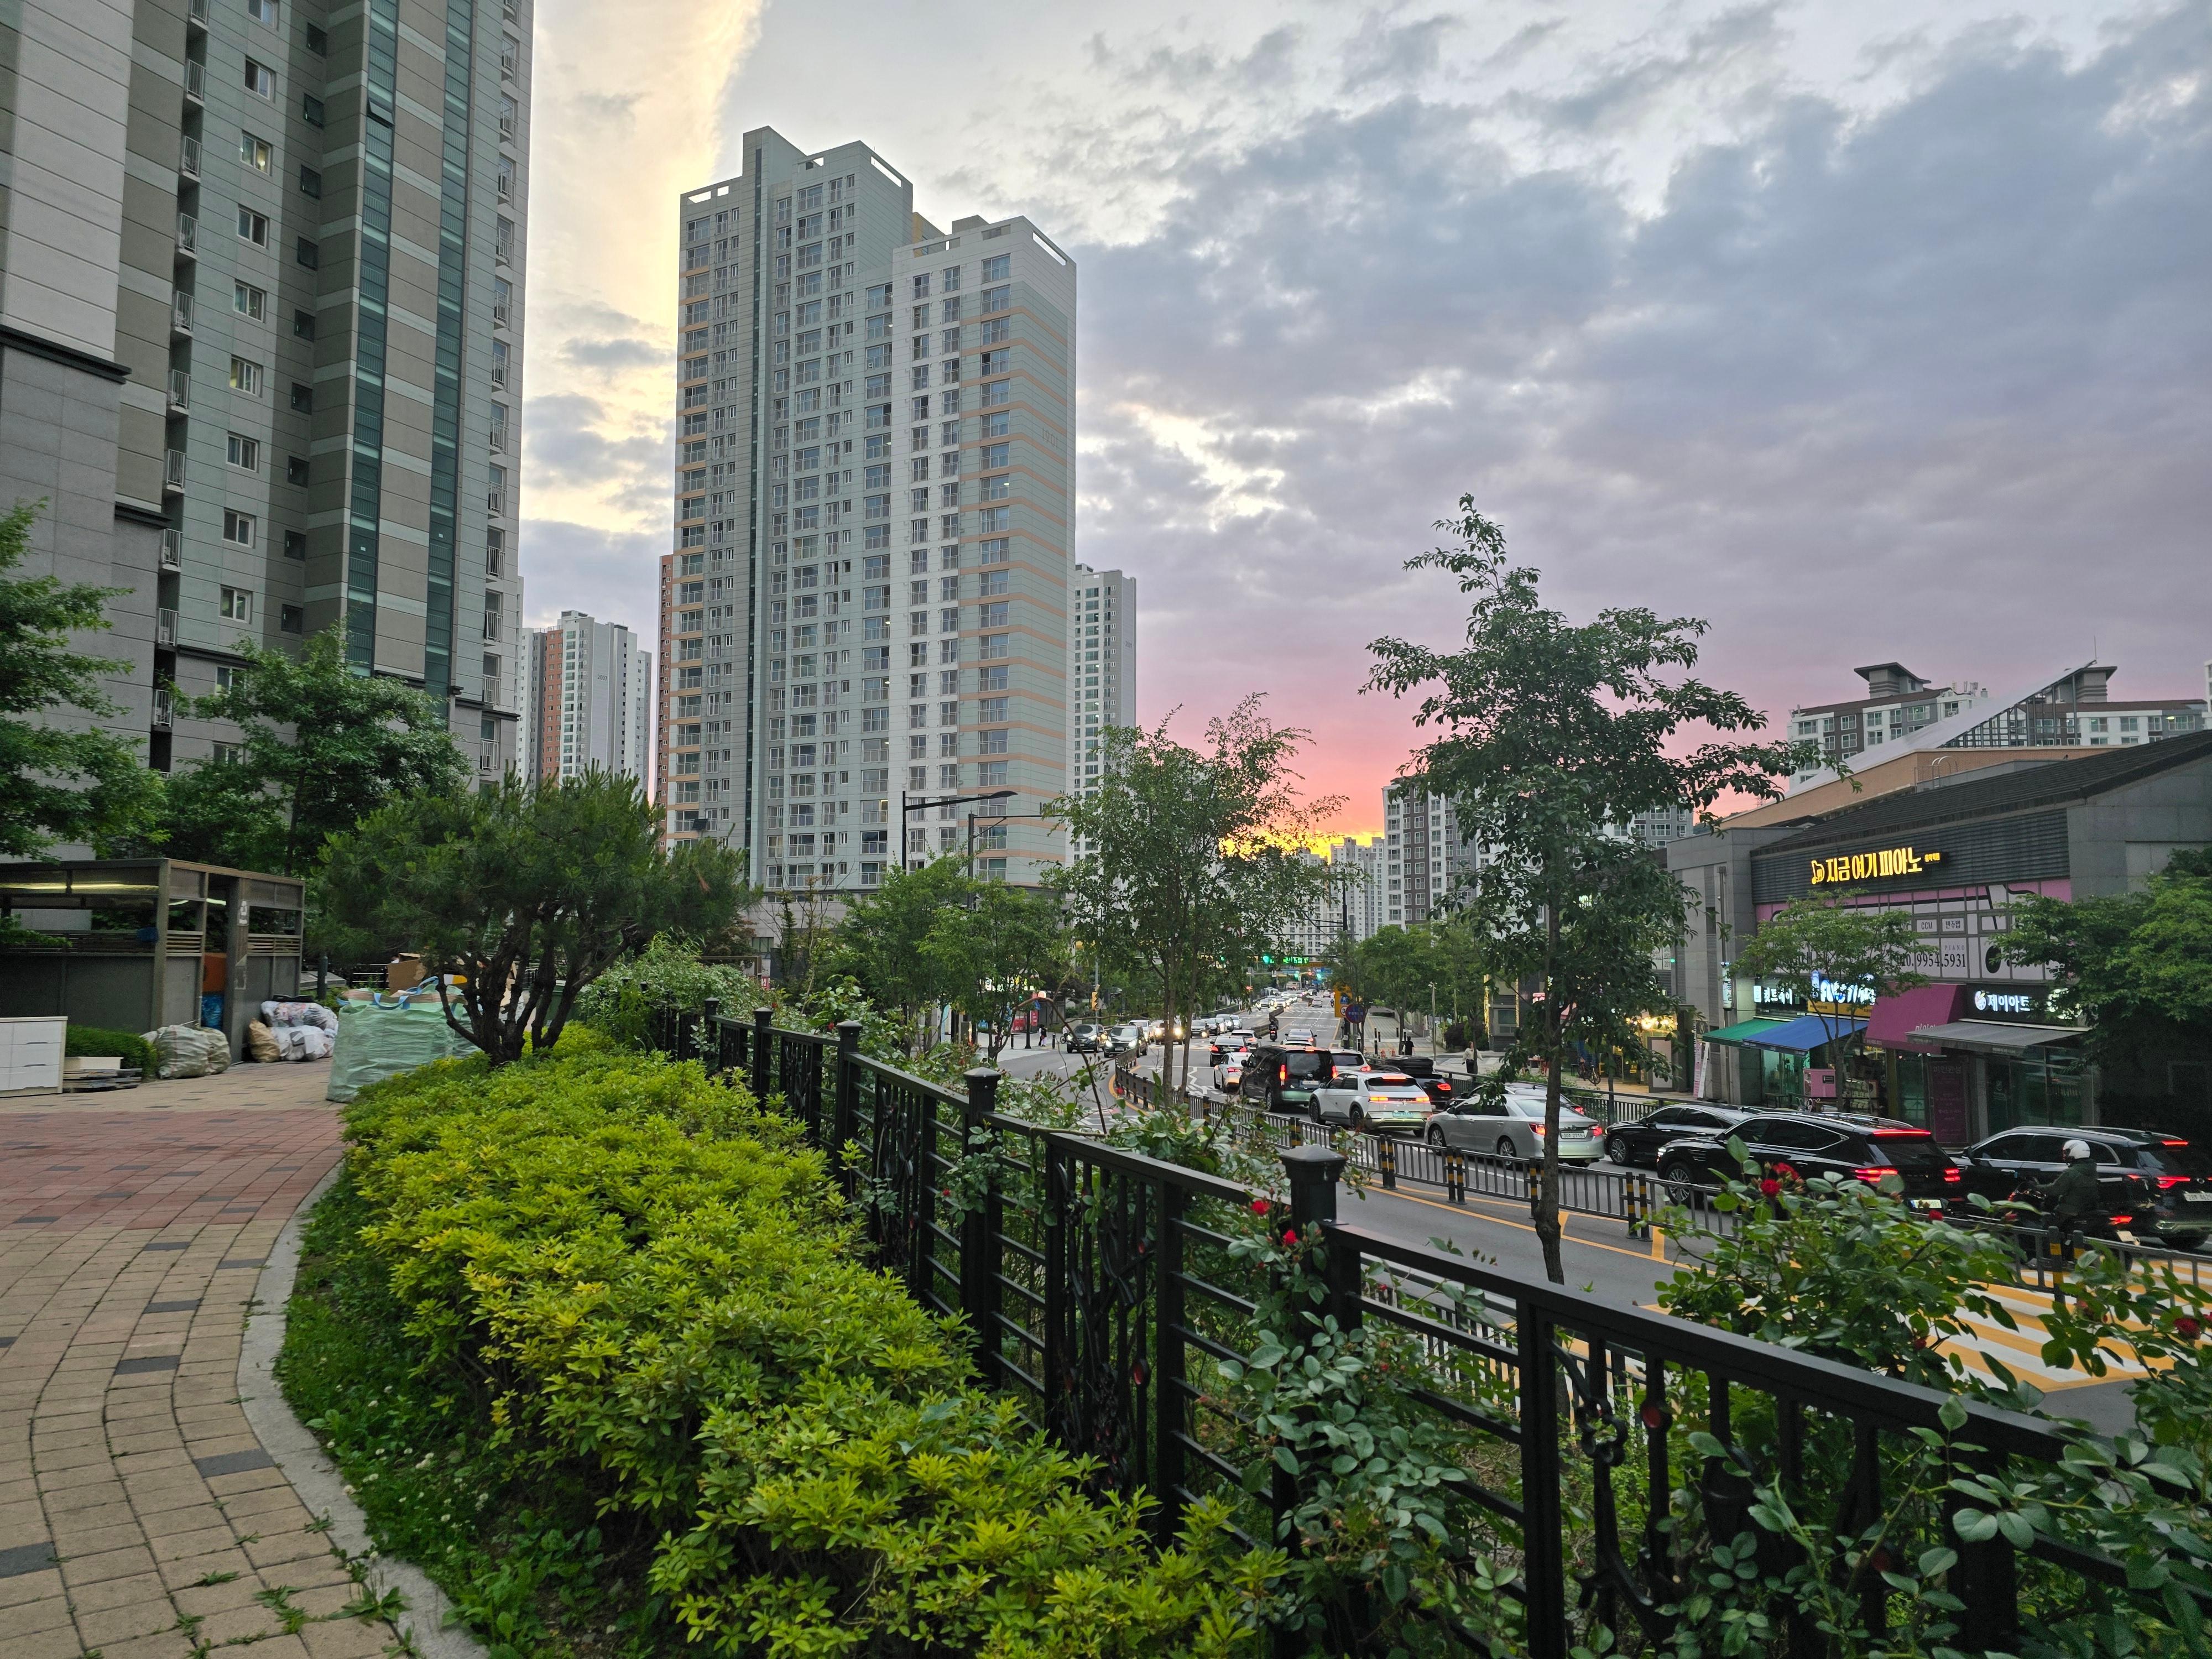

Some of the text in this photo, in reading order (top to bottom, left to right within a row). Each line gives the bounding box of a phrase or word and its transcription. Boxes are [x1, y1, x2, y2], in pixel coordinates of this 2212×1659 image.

[1825, 857, 1850, 883] 지금
[1851, 853, 1877, 880] 여기
[1879, 847, 1923, 877] 피아노
[1921, 921, 1933, 930] CCM
[1987, 994, 2031, 1013] 제이아트
